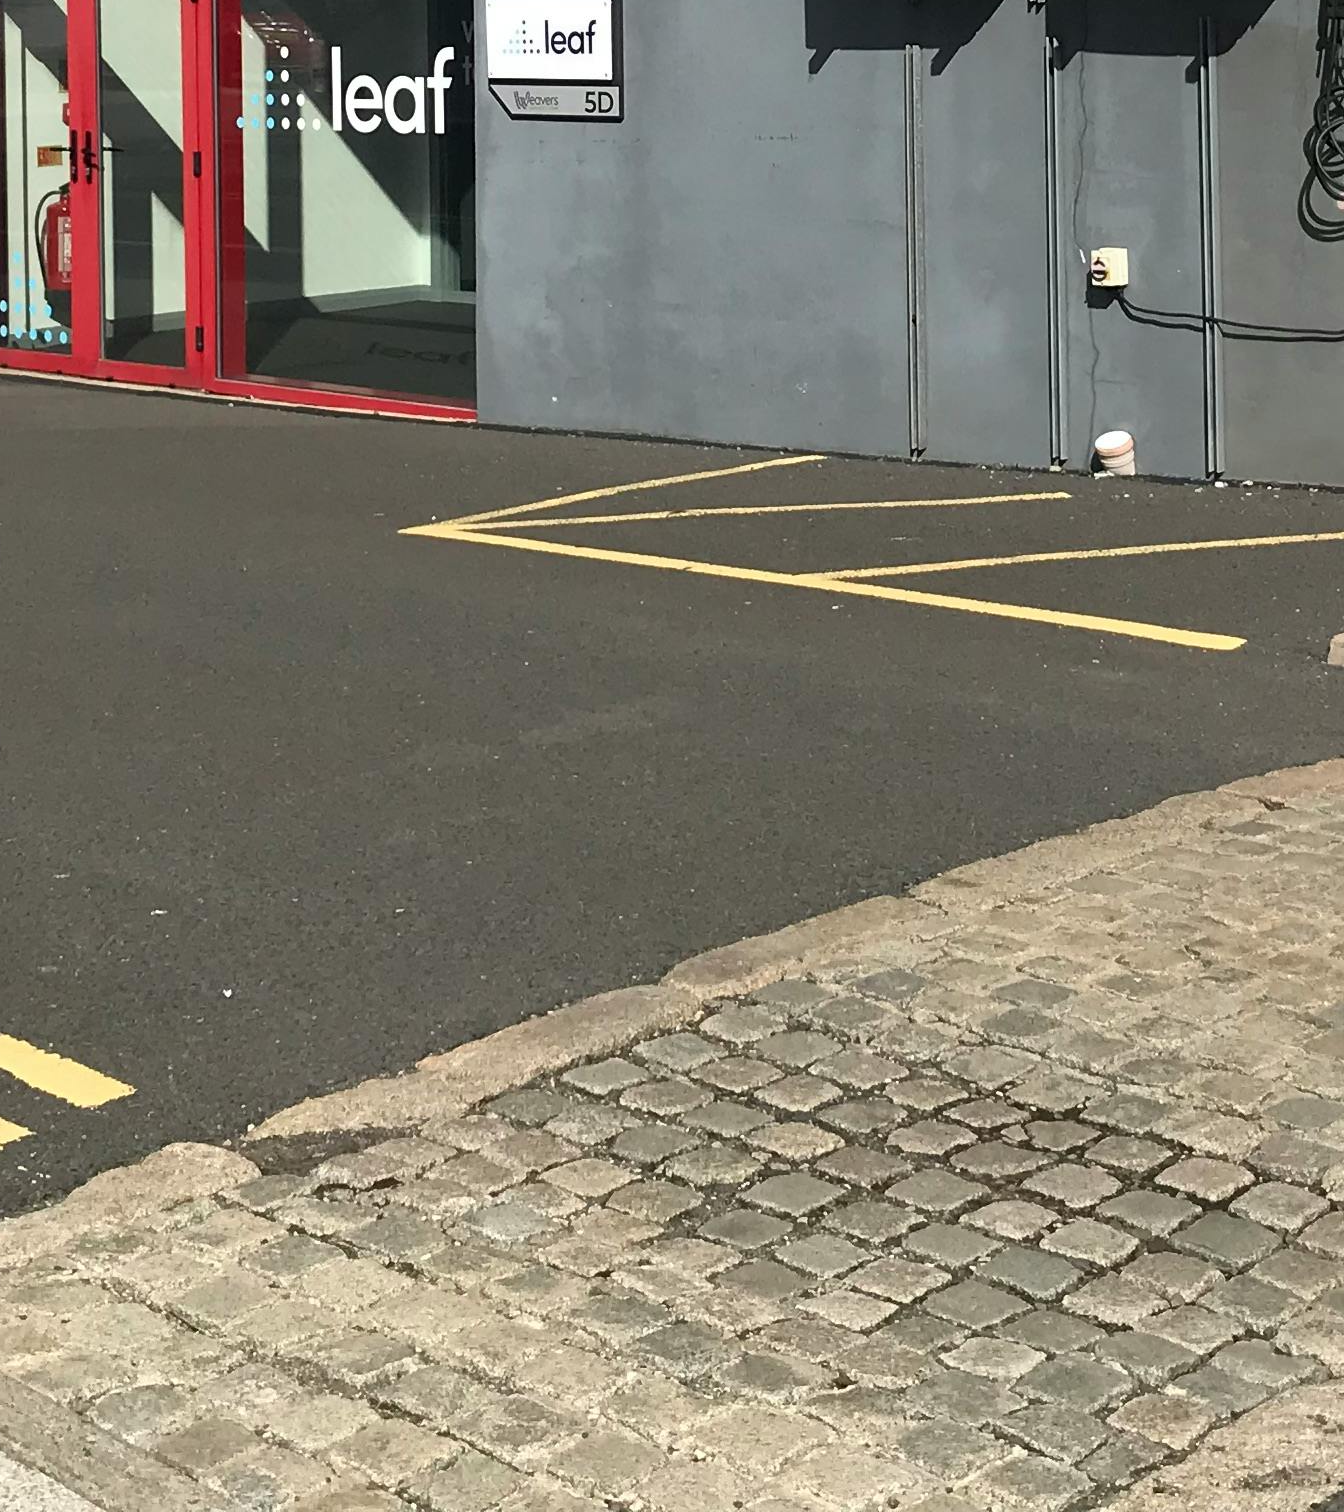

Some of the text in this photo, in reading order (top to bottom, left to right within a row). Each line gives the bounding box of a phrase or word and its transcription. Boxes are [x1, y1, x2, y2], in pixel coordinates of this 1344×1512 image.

[544, 19, 597, 55] leaf
[331, 46, 454, 134] leaf
[585, 91, 614, 113] 5D
